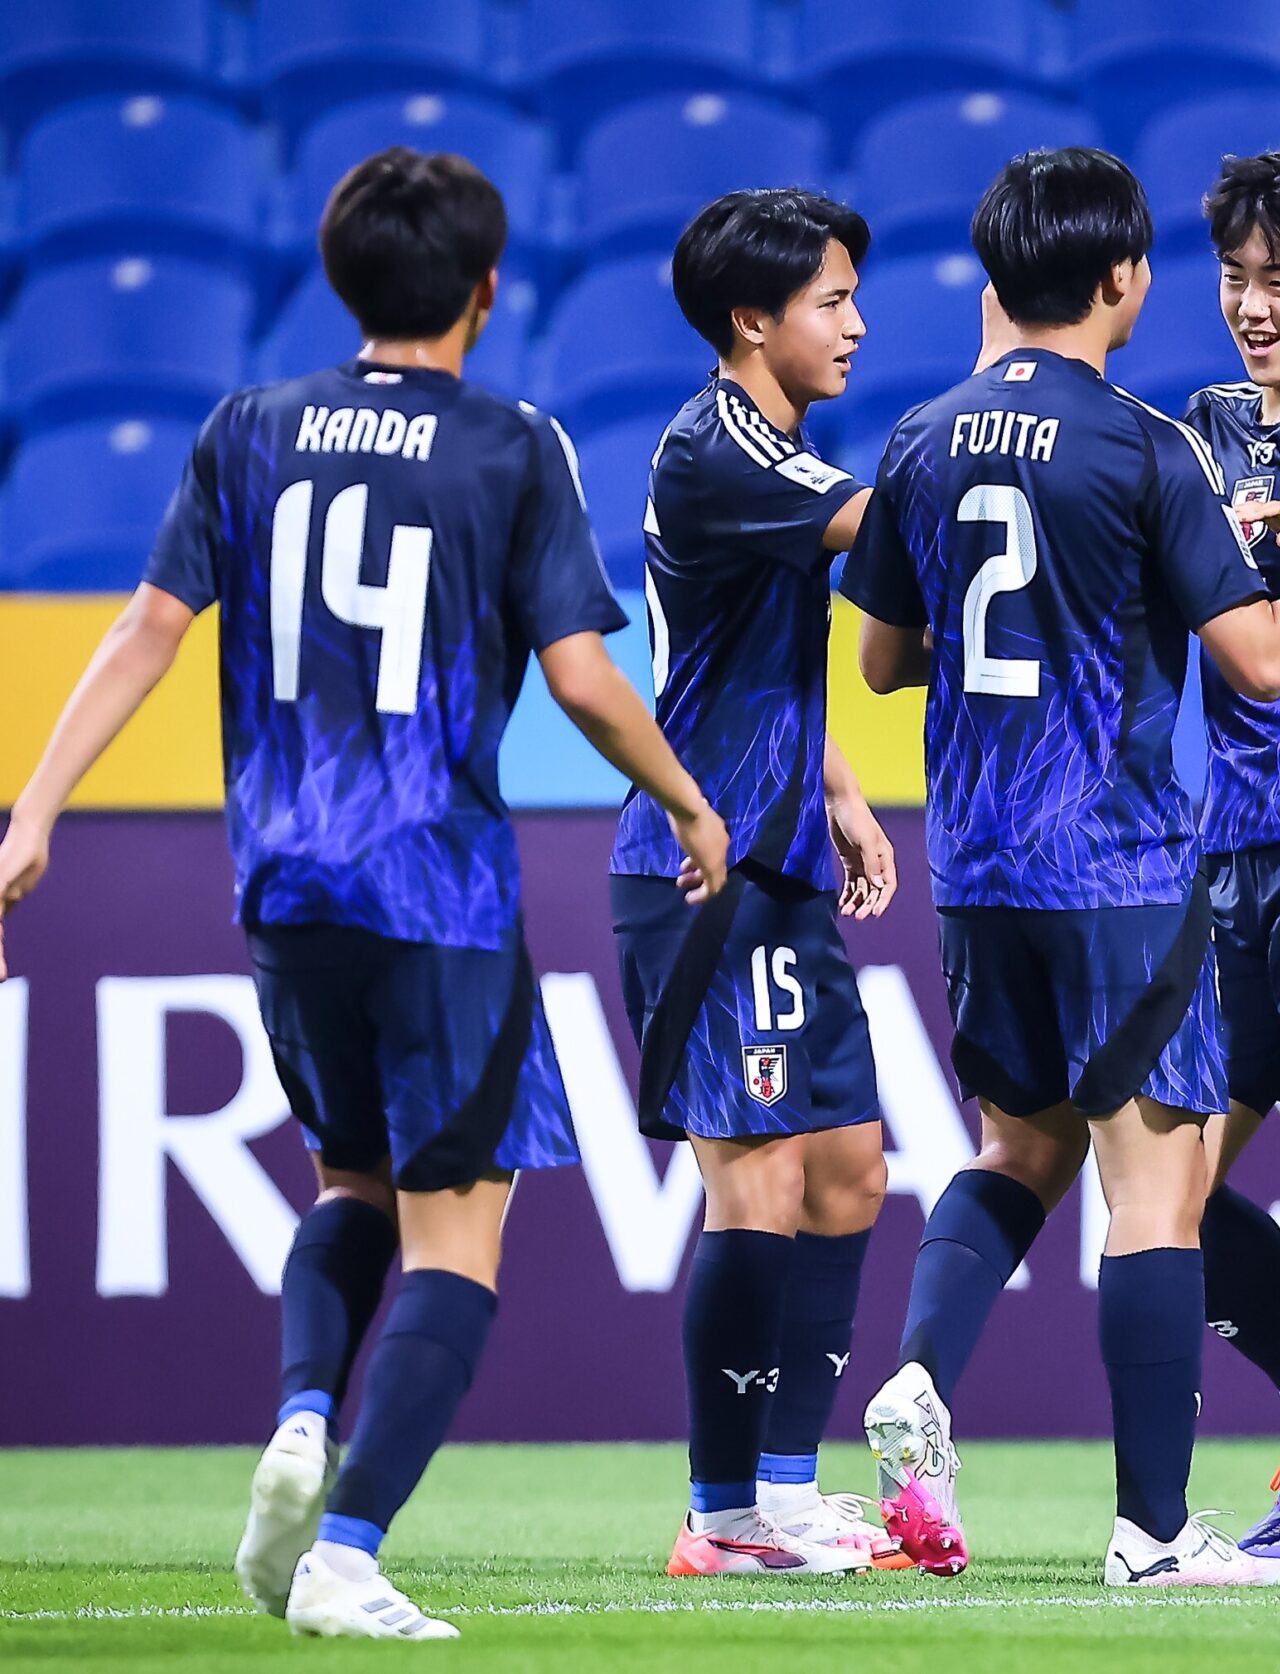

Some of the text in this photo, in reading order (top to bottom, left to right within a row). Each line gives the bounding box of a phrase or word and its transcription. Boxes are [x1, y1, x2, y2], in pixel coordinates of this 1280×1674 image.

[295, 405, 439, 462] KANDA
[949, 410, 1060, 462] FUJITA
[1247, 441, 1277, 468] Y-3
[270, 479, 433, 716] 14
[956, 484, 1040, 697] 2
[751, 945, 806, 1030] 15
[721, 1367, 780, 1394] Y-3
